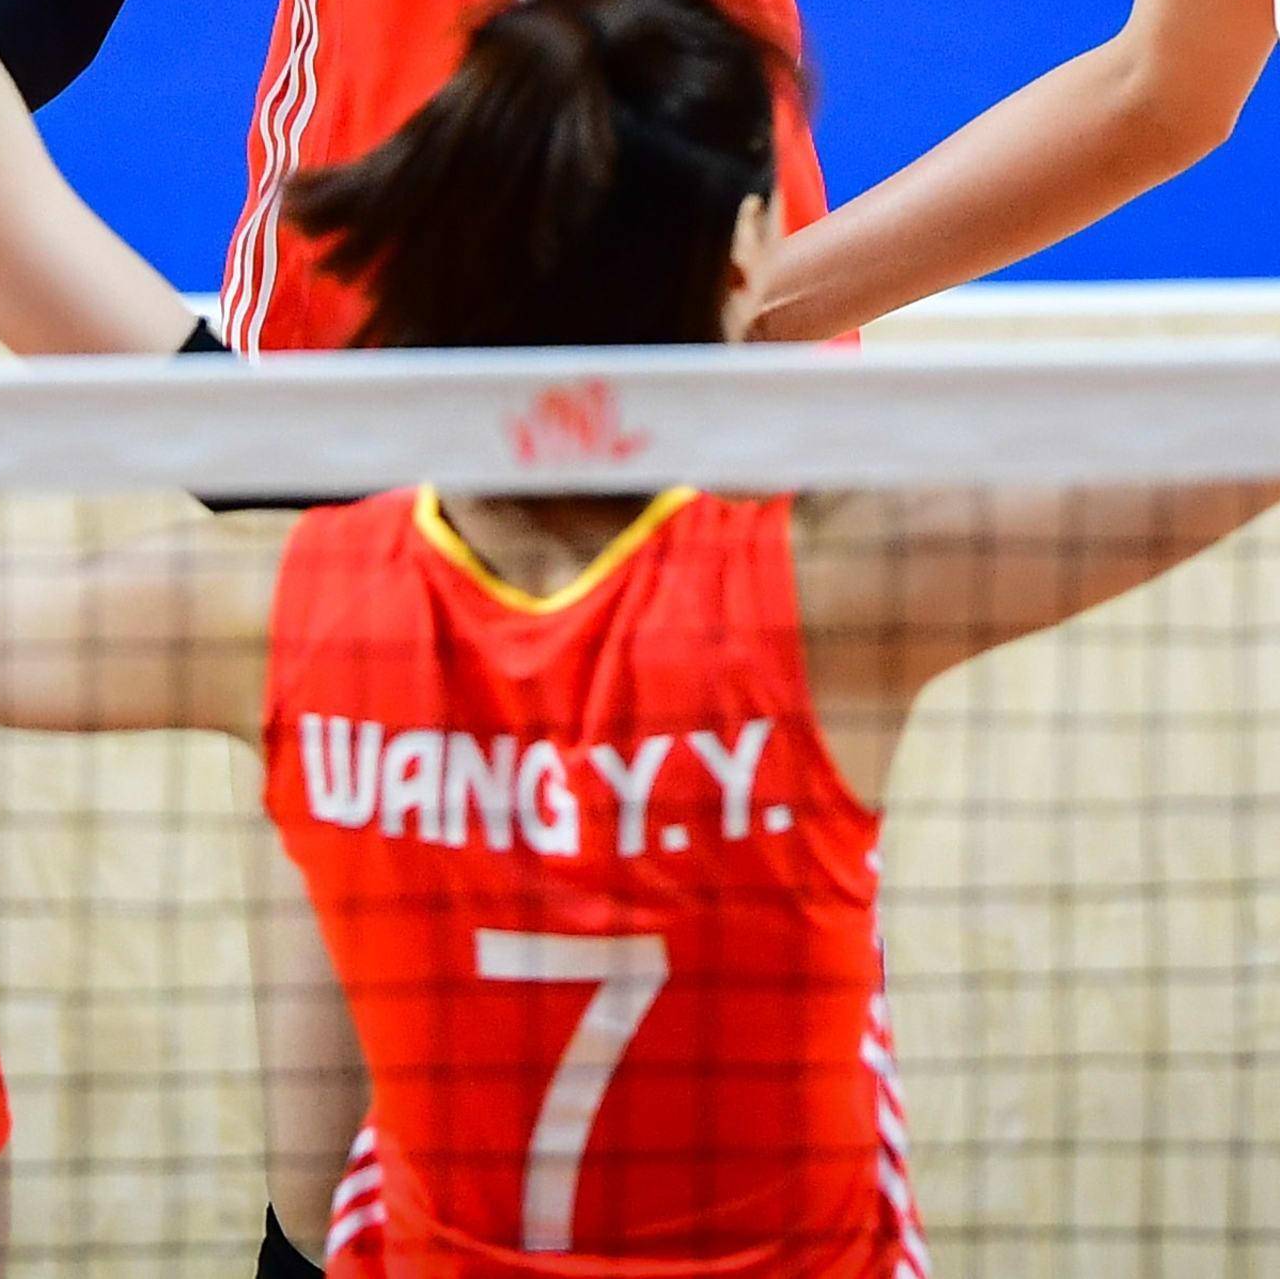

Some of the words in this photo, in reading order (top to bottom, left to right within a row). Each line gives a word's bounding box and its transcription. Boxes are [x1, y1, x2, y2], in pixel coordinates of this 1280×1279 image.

[299, 712, 579, 857] WANG
[589, 718, 792, 857] Y.Y.
[474, 927, 670, 1253] 7
